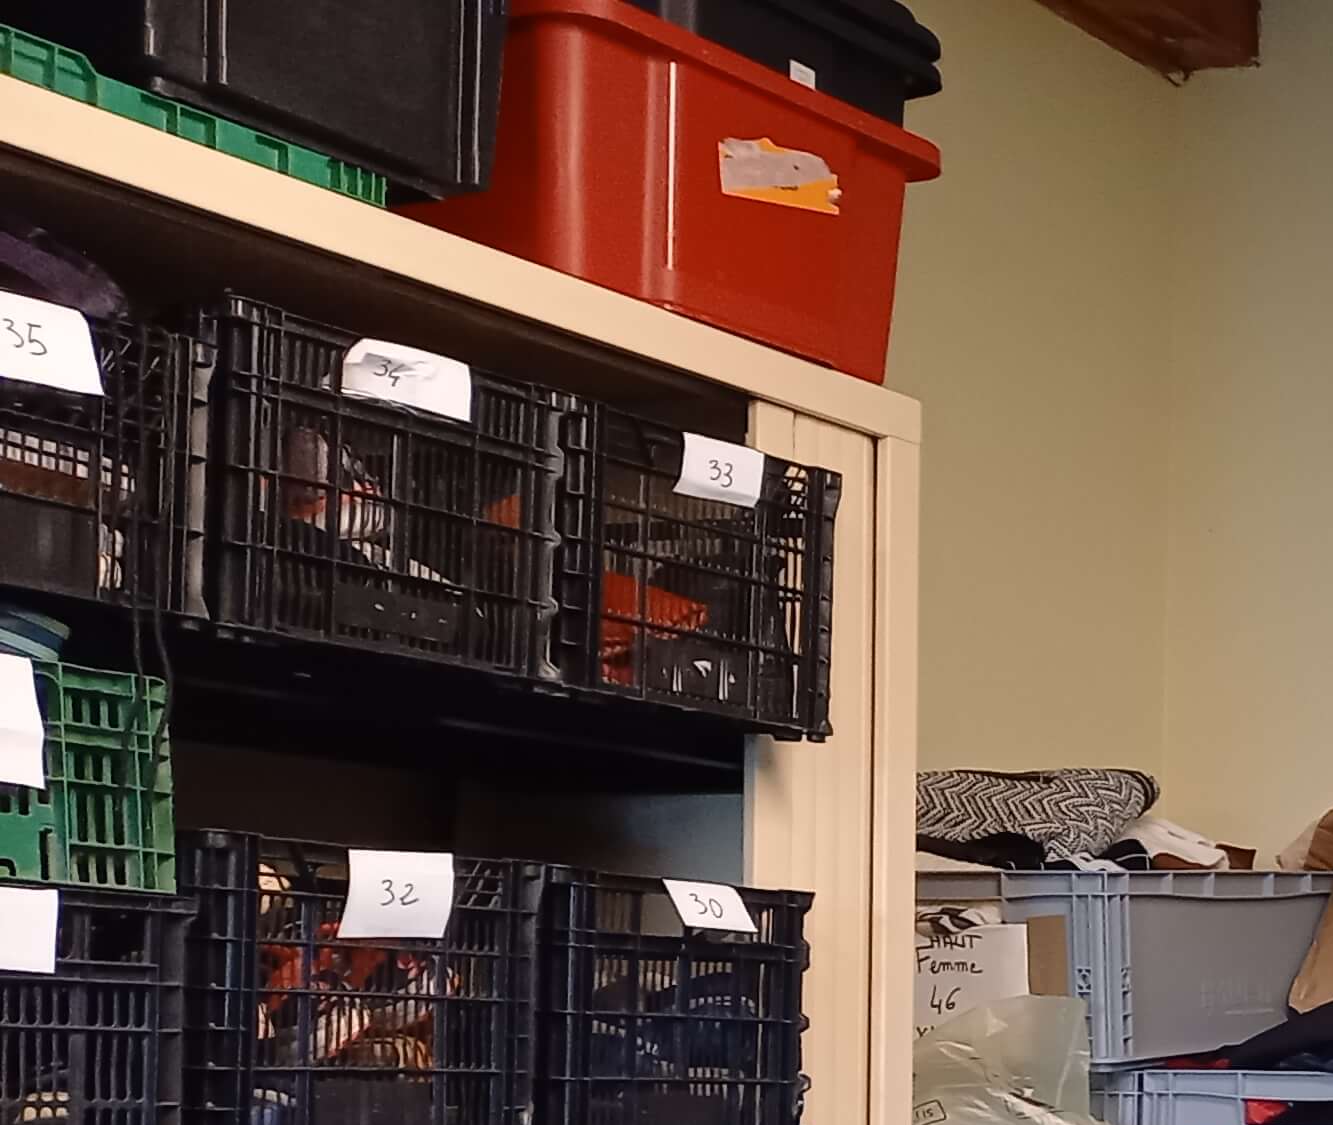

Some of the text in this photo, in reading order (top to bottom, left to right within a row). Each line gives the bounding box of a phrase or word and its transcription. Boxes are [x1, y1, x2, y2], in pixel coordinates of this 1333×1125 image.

[3, 318, 47, 356] 35
[373, 359, 400, 387] 34
[708, 459, 734, 488] 33
[380, 879, 420, 906] 32
[688, 893, 724, 919] 30
[915, 945, 983, 974] Femme
[930, 984, 961, 1014] 46
